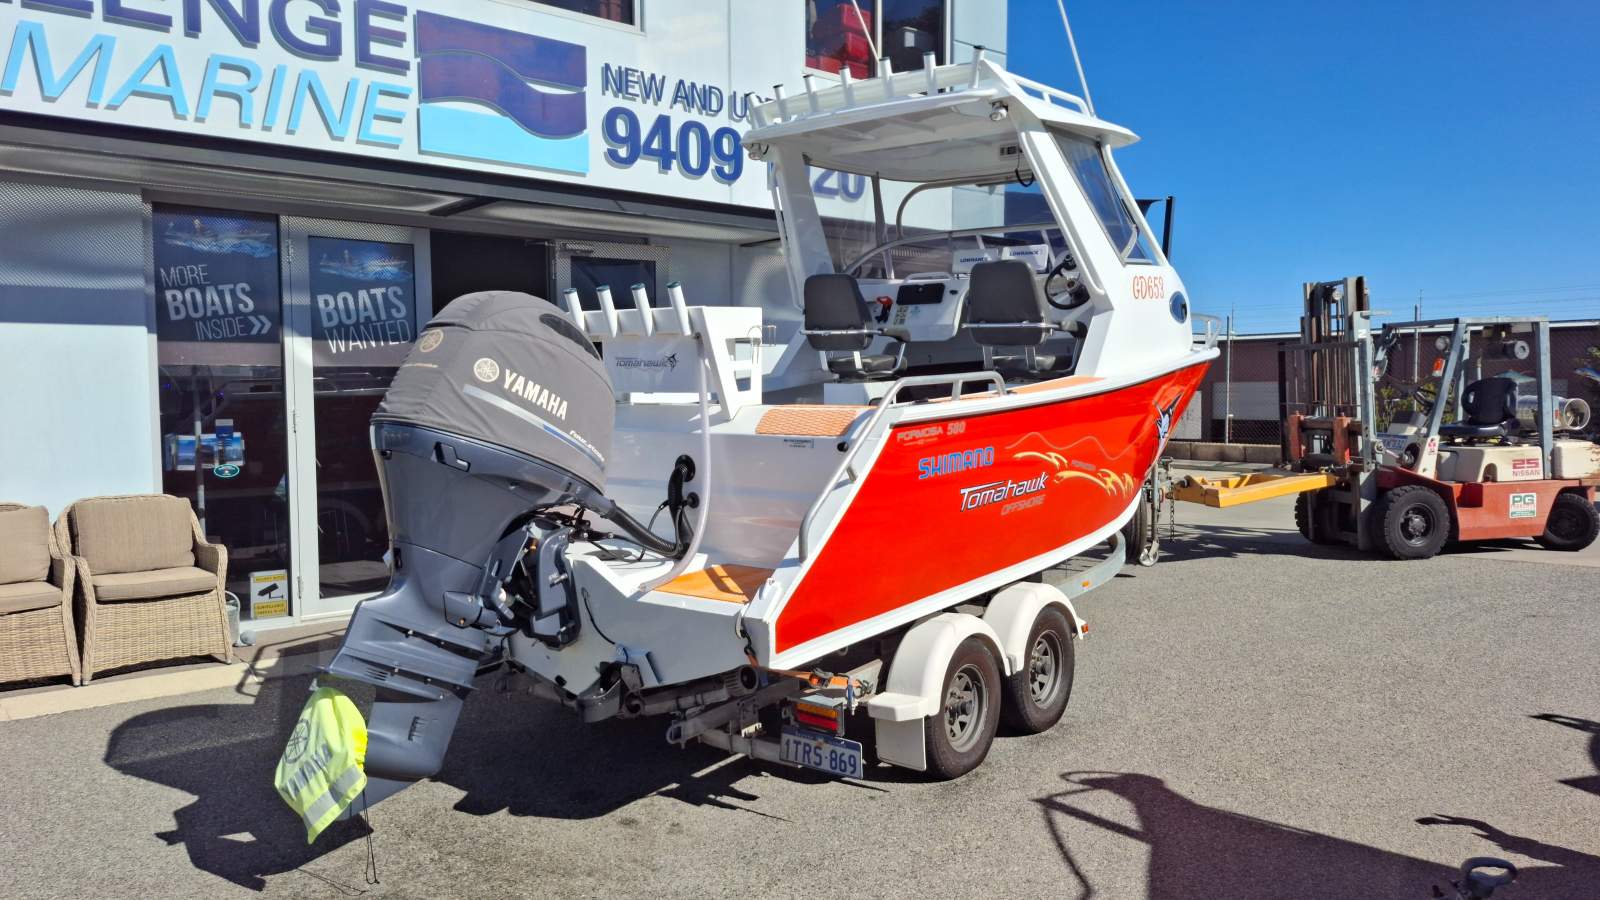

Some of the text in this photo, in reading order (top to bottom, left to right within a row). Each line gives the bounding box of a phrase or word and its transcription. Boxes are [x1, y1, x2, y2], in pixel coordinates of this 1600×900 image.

[0, 20, 413, 148] MARINE
[602, 63, 665, 106] NEW
[670, 79, 724, 117] AND
[602, 106, 744, 185] 9409
[160, 264, 210, 288] MORE
[165, 282, 255, 321] BOATS
[317, 285, 407, 328] BOATS
[195, 316, 249, 341] INSIDE
[325, 319, 411, 354] WANTED
[503, 368, 568, 421] YAMAHA
[897, 426, 943, 442] FORMOSA
[918, 446, 995, 480] SHIMANO
[1511, 458, 1540, 470] 25
[960, 471, 1049, 512] Tomahawk
[1511, 494, 1535, 505] PG
